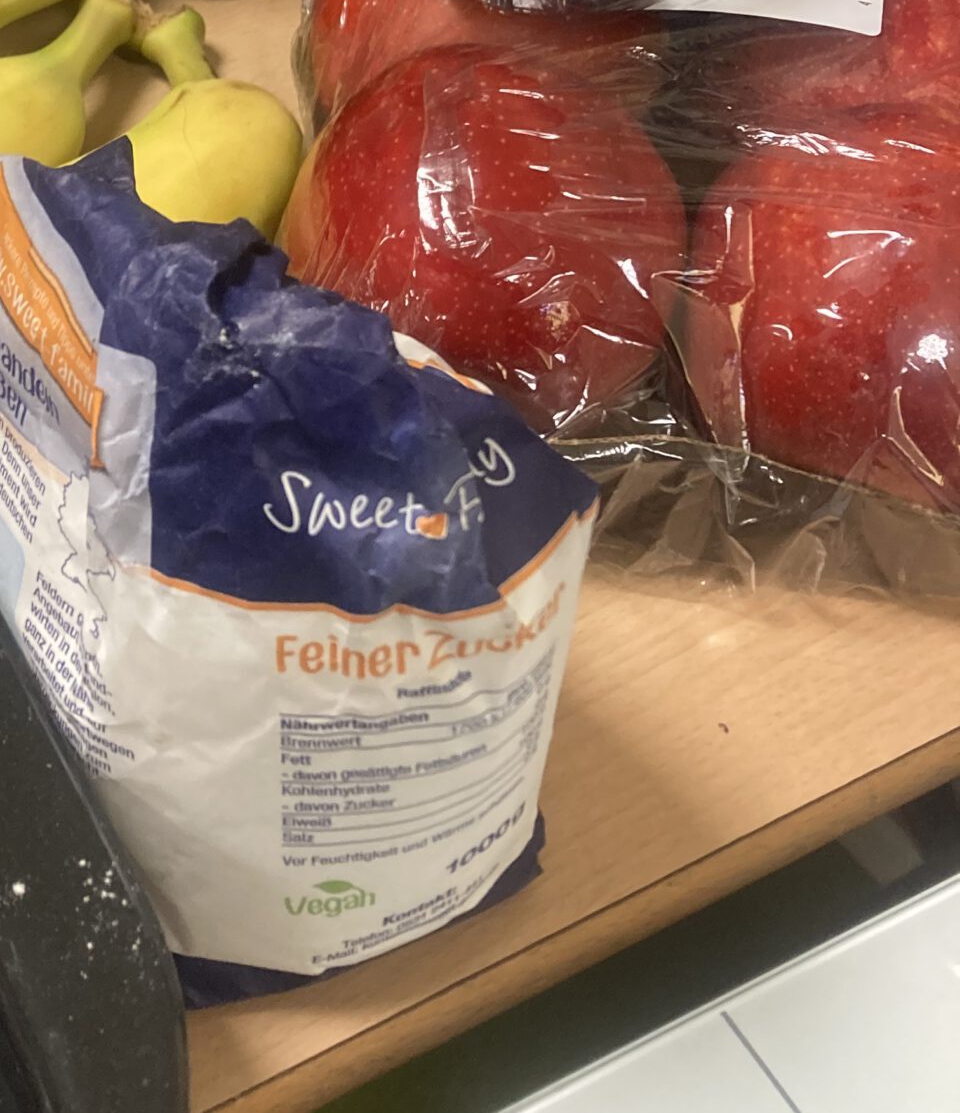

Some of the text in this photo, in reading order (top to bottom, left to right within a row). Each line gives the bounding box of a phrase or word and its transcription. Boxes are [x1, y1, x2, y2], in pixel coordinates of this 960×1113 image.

[1, 441, 22, 477] Denn
[21, 471, 42, 511] unser
[5, 426, 46, 496] produzieren
[20, 492, 38, 528] wird
[263, 470, 425, 537] Sweet
[36, 569, 76, 617] Feldern
[30, 601, 59, 643] wirten
[58, 637, 71, 655] in
[24, 617, 47, 650] ganz
[45, 646, 56, 664] in
[55, 659, 73, 683] der
[275, 634, 421, 680] Feiner
[280, 712, 430, 732] Nährwertangaben
[280, 736, 362, 749] Brennwert
[280, 753, 312, 766] Fett
[292, 770, 338, 781] davon
[340, 764, 412, 784] gesättigte
[281, 783, 390, 798] Kohlenhydrate
[293, 797, 396, 813] davon Zucker
[281, 816, 332, 828] Eiweiß
[281, 832, 315, 844] Salz
[282, 855, 307, 867] Vor
[311, 846, 399, 867] Feuchtigkeit
[401, 837, 429, 854] und
[283, 886, 376, 918] Vegan
[382, 885, 458, 928] Kontakt:
